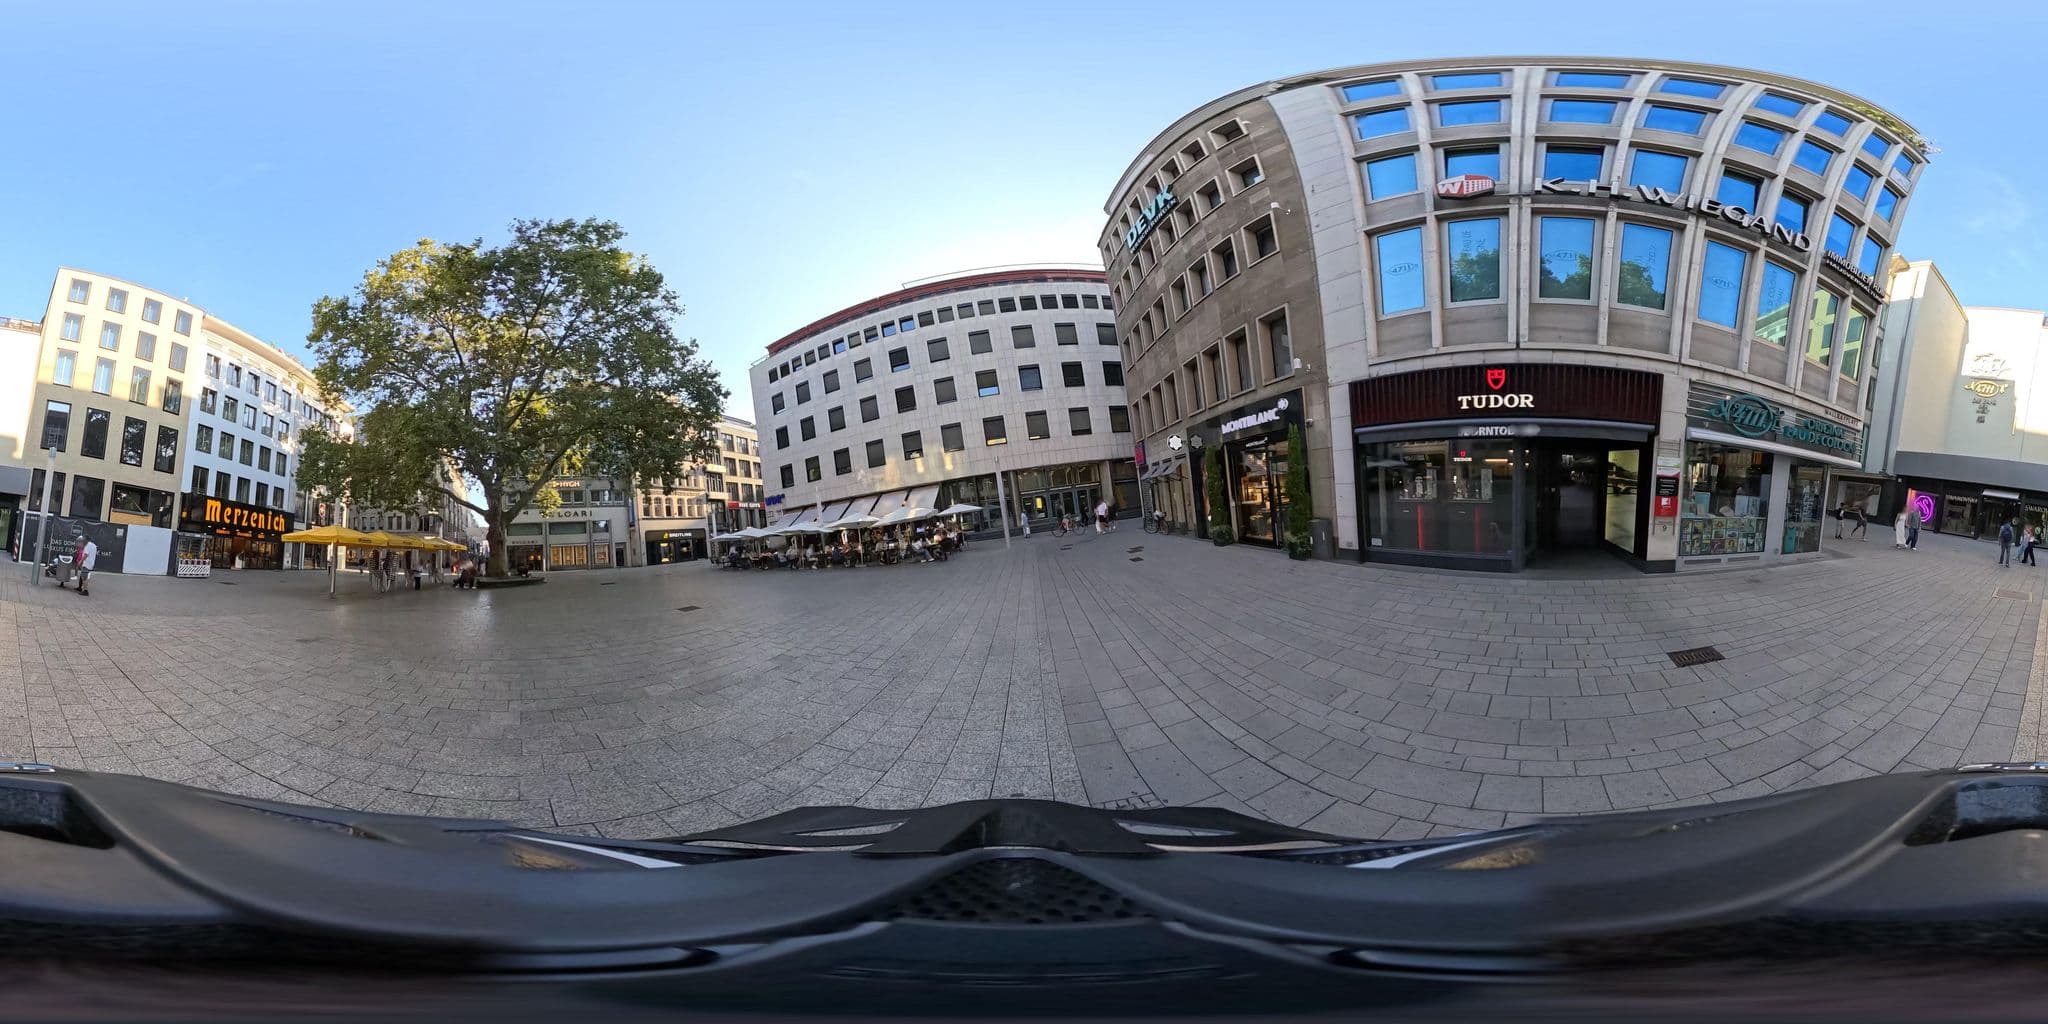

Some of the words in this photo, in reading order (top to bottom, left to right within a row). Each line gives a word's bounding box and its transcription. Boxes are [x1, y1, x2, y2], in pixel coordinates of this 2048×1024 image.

[1126, 184, 1174, 249] DEVK
[1636, 184, 1811, 253] WIEGAND
[1221, 408, 1281, 434] MONTBLANC
[1457, 394, 1535, 409] TUDOR
